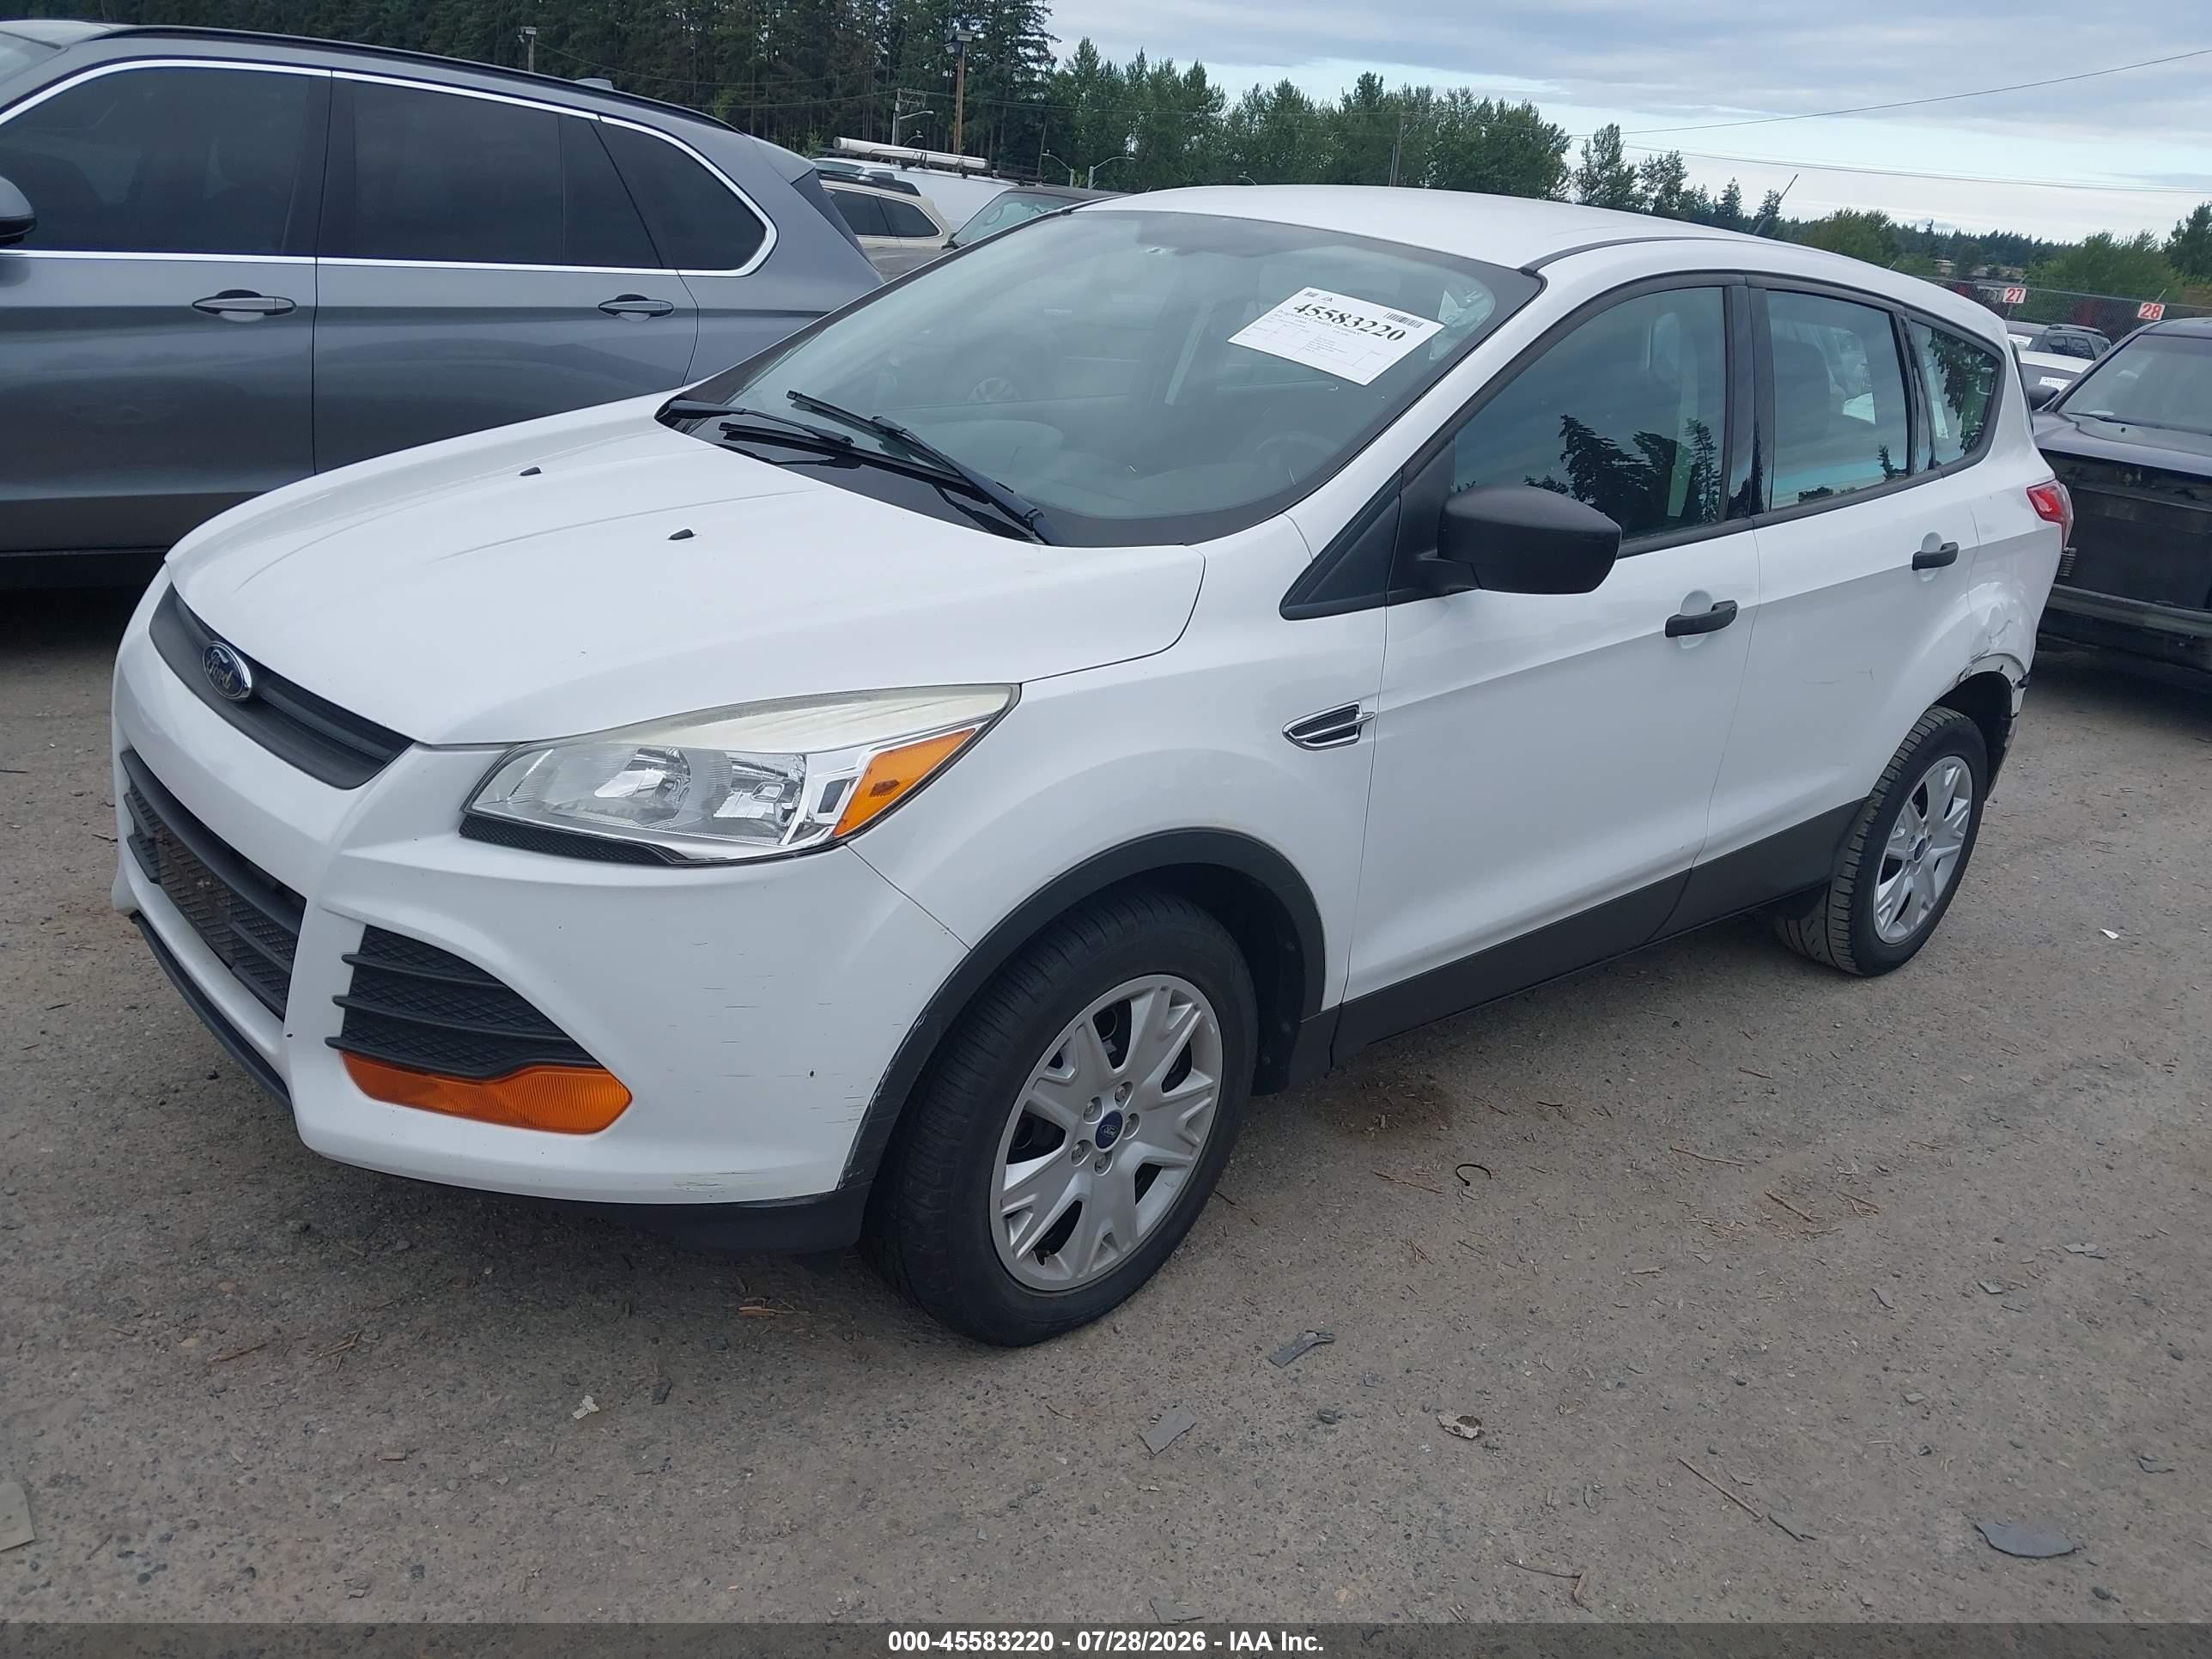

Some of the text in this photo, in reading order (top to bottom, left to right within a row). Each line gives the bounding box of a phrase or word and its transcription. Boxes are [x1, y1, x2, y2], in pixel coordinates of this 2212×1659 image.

[2006, 289, 2024, 302] 27
[1293, 303, 1407, 341] 45583220
[2140, 303, 2161, 319] 28
[206, 649, 234, 689] Ford
